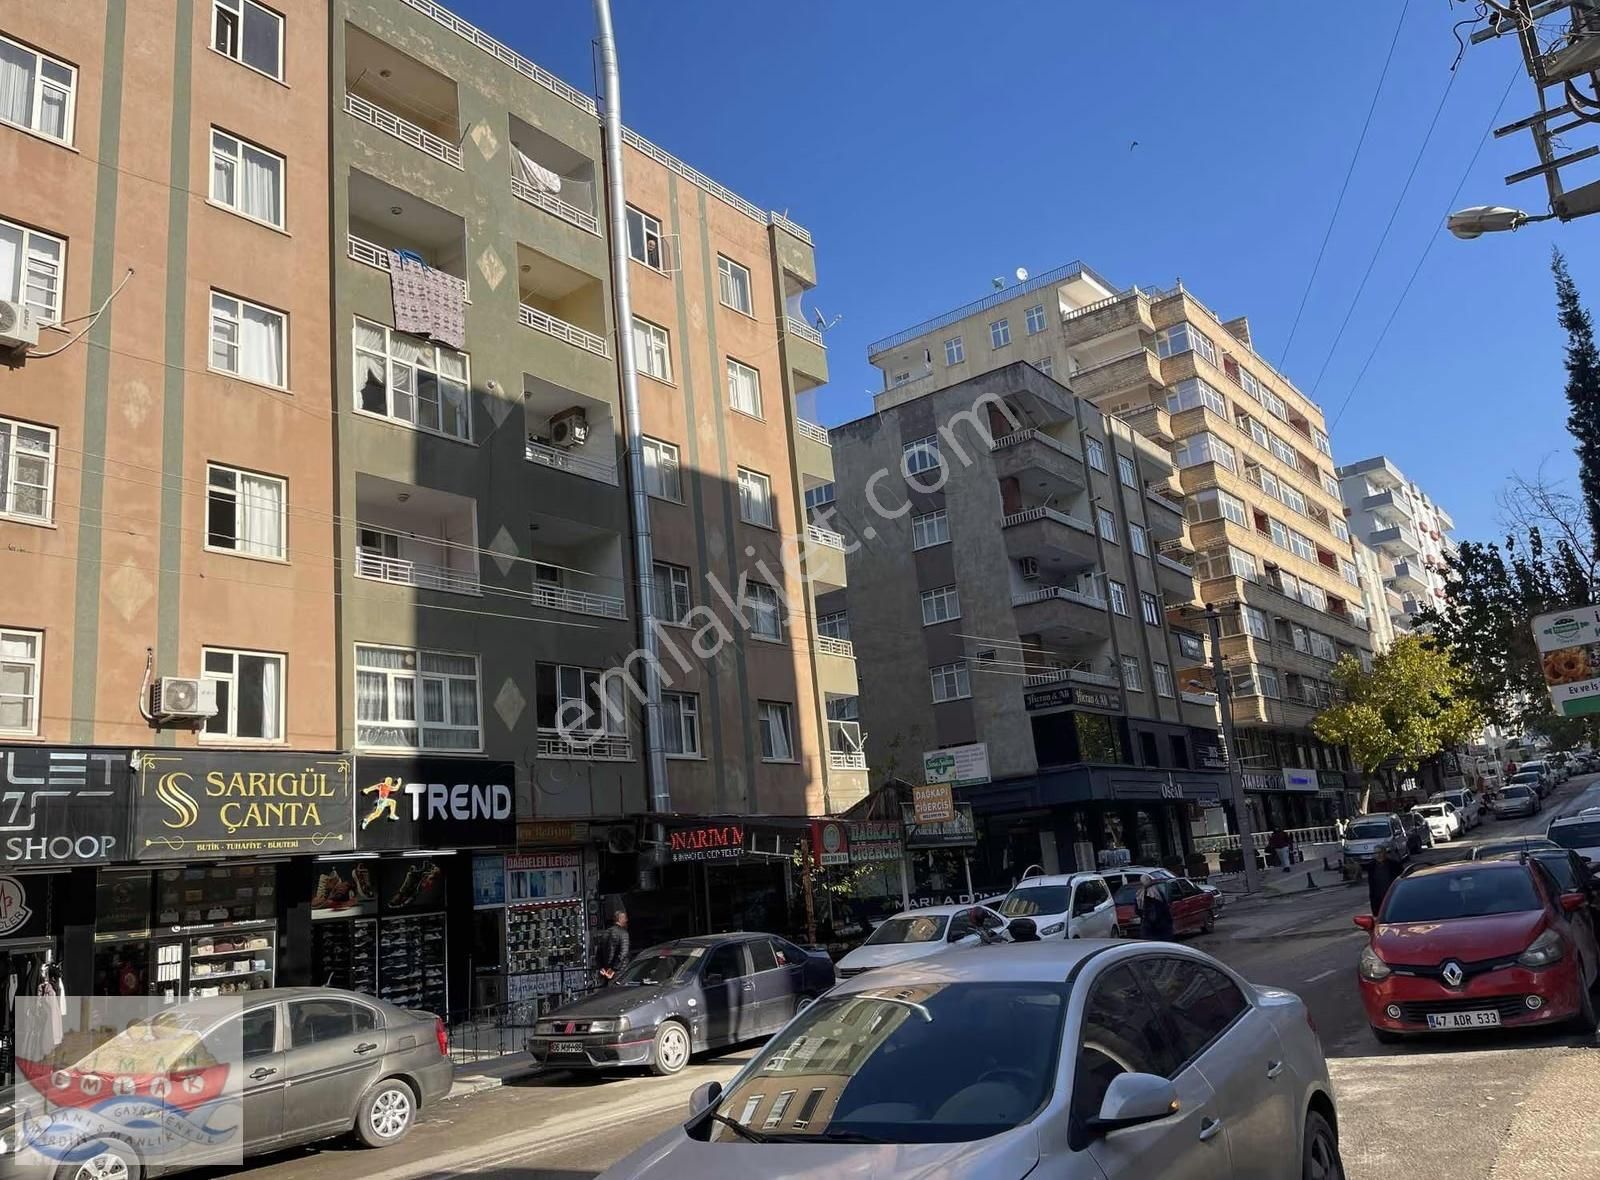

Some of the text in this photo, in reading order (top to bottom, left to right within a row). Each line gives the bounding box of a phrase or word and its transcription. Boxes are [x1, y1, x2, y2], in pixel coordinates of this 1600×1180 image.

[1569, 686, 1579, 695] Ev
[1580, 684, 1590, 693] ve
[0, 752, 126, 785] LET
[205, 768, 335, 797] SARIGÜL
[404, 783, 511, 821] TREND
[220, 802, 322, 834] ÇANTA
[6, 835, 117, 861] SHOOP
[196, 842, 220, 852] BUTİK
[1435, 1012, 1497, 1027] 47 ADR 533
